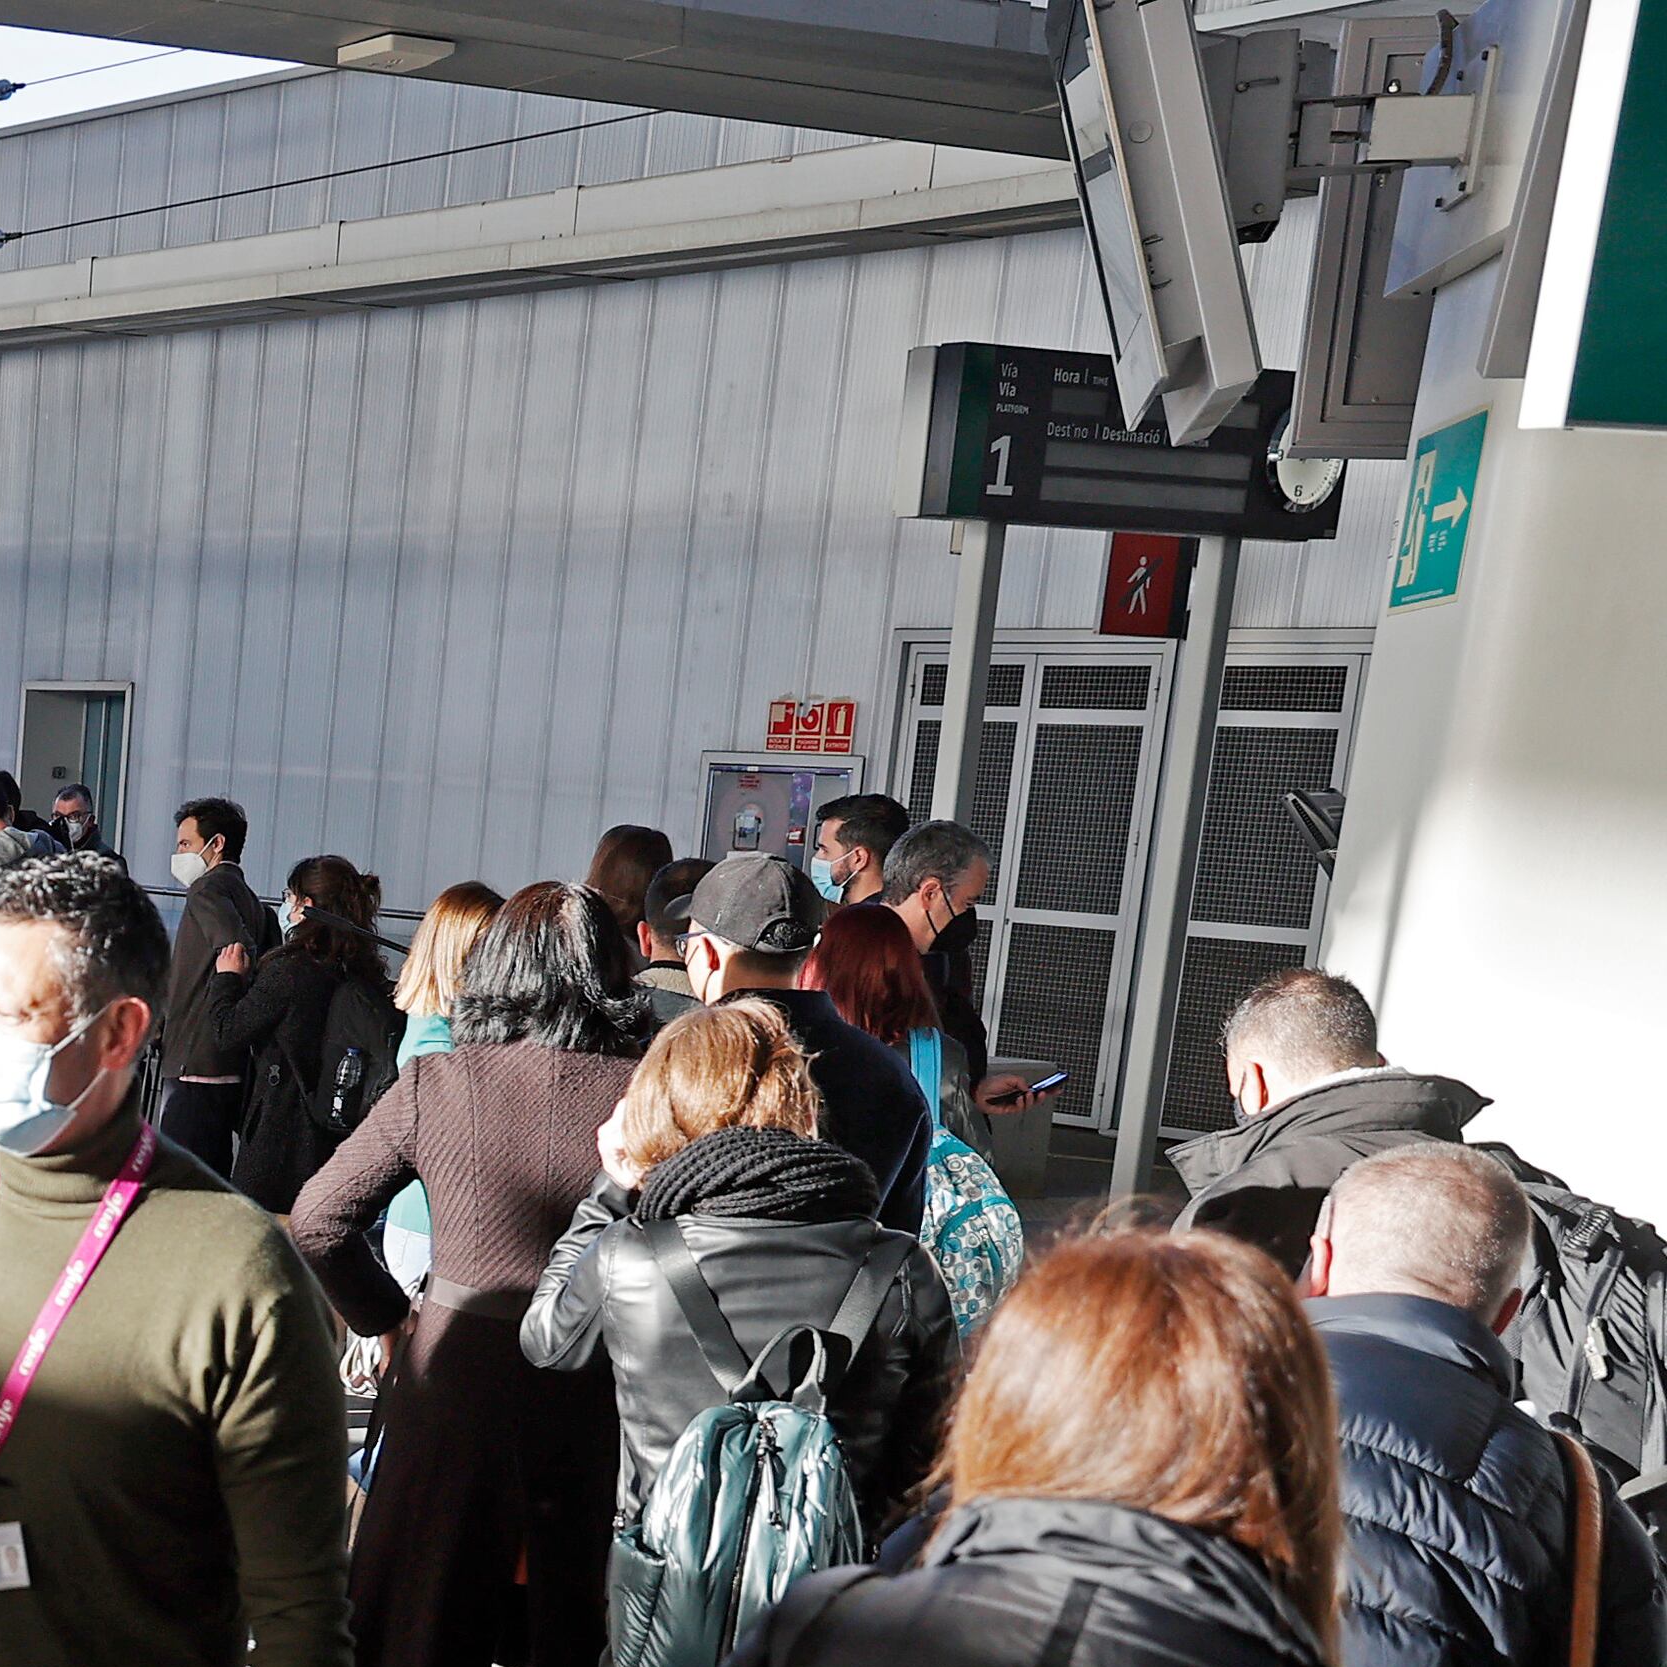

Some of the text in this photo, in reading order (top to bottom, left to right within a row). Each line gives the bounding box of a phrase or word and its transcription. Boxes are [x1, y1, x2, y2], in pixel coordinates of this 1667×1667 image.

[1000, 362, 1018, 378] Vía
[1054, 367, 1081, 384] Hora
[999, 381, 1017, 397] Via
[996, 403, 1029, 415] PLATFORM
[985, 435, 1014, 497] 1
